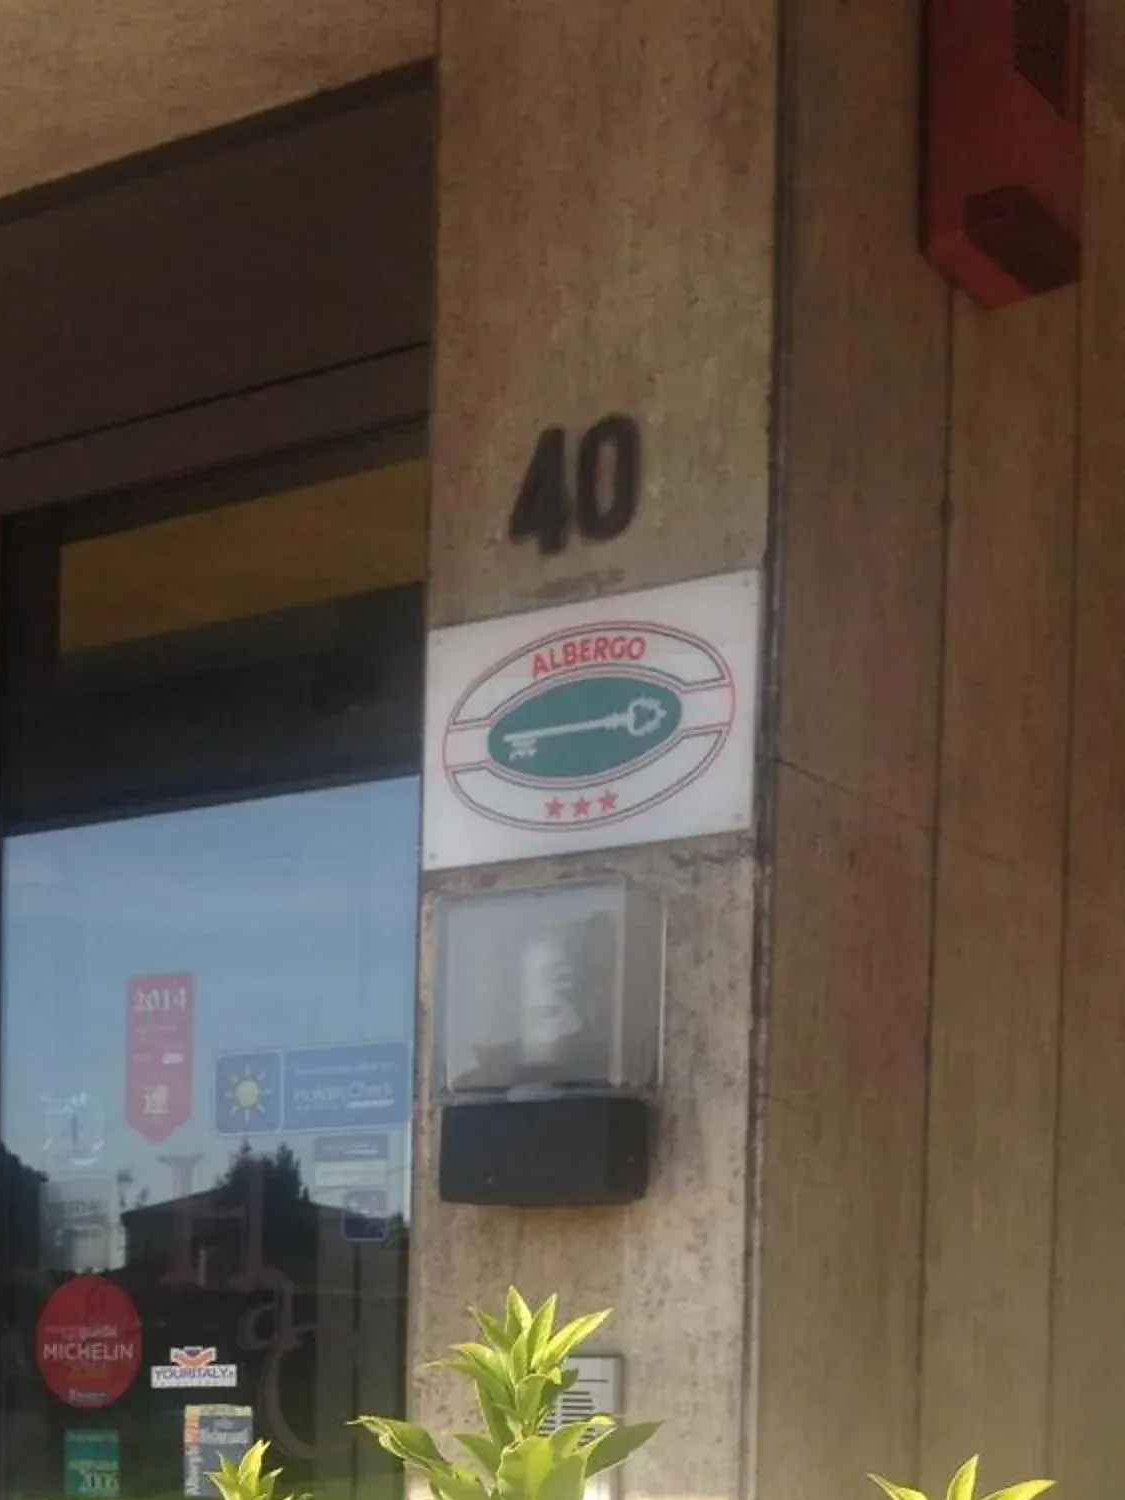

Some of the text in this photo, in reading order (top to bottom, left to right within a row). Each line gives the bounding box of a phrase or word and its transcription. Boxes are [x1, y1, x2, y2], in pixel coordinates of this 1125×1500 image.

[508, 412, 641, 555] 40
[530, 635, 647, 679] ALBERGO
[133, 987, 188, 1013] 2014
[43, 1342, 134, 1361] MICHELIN
